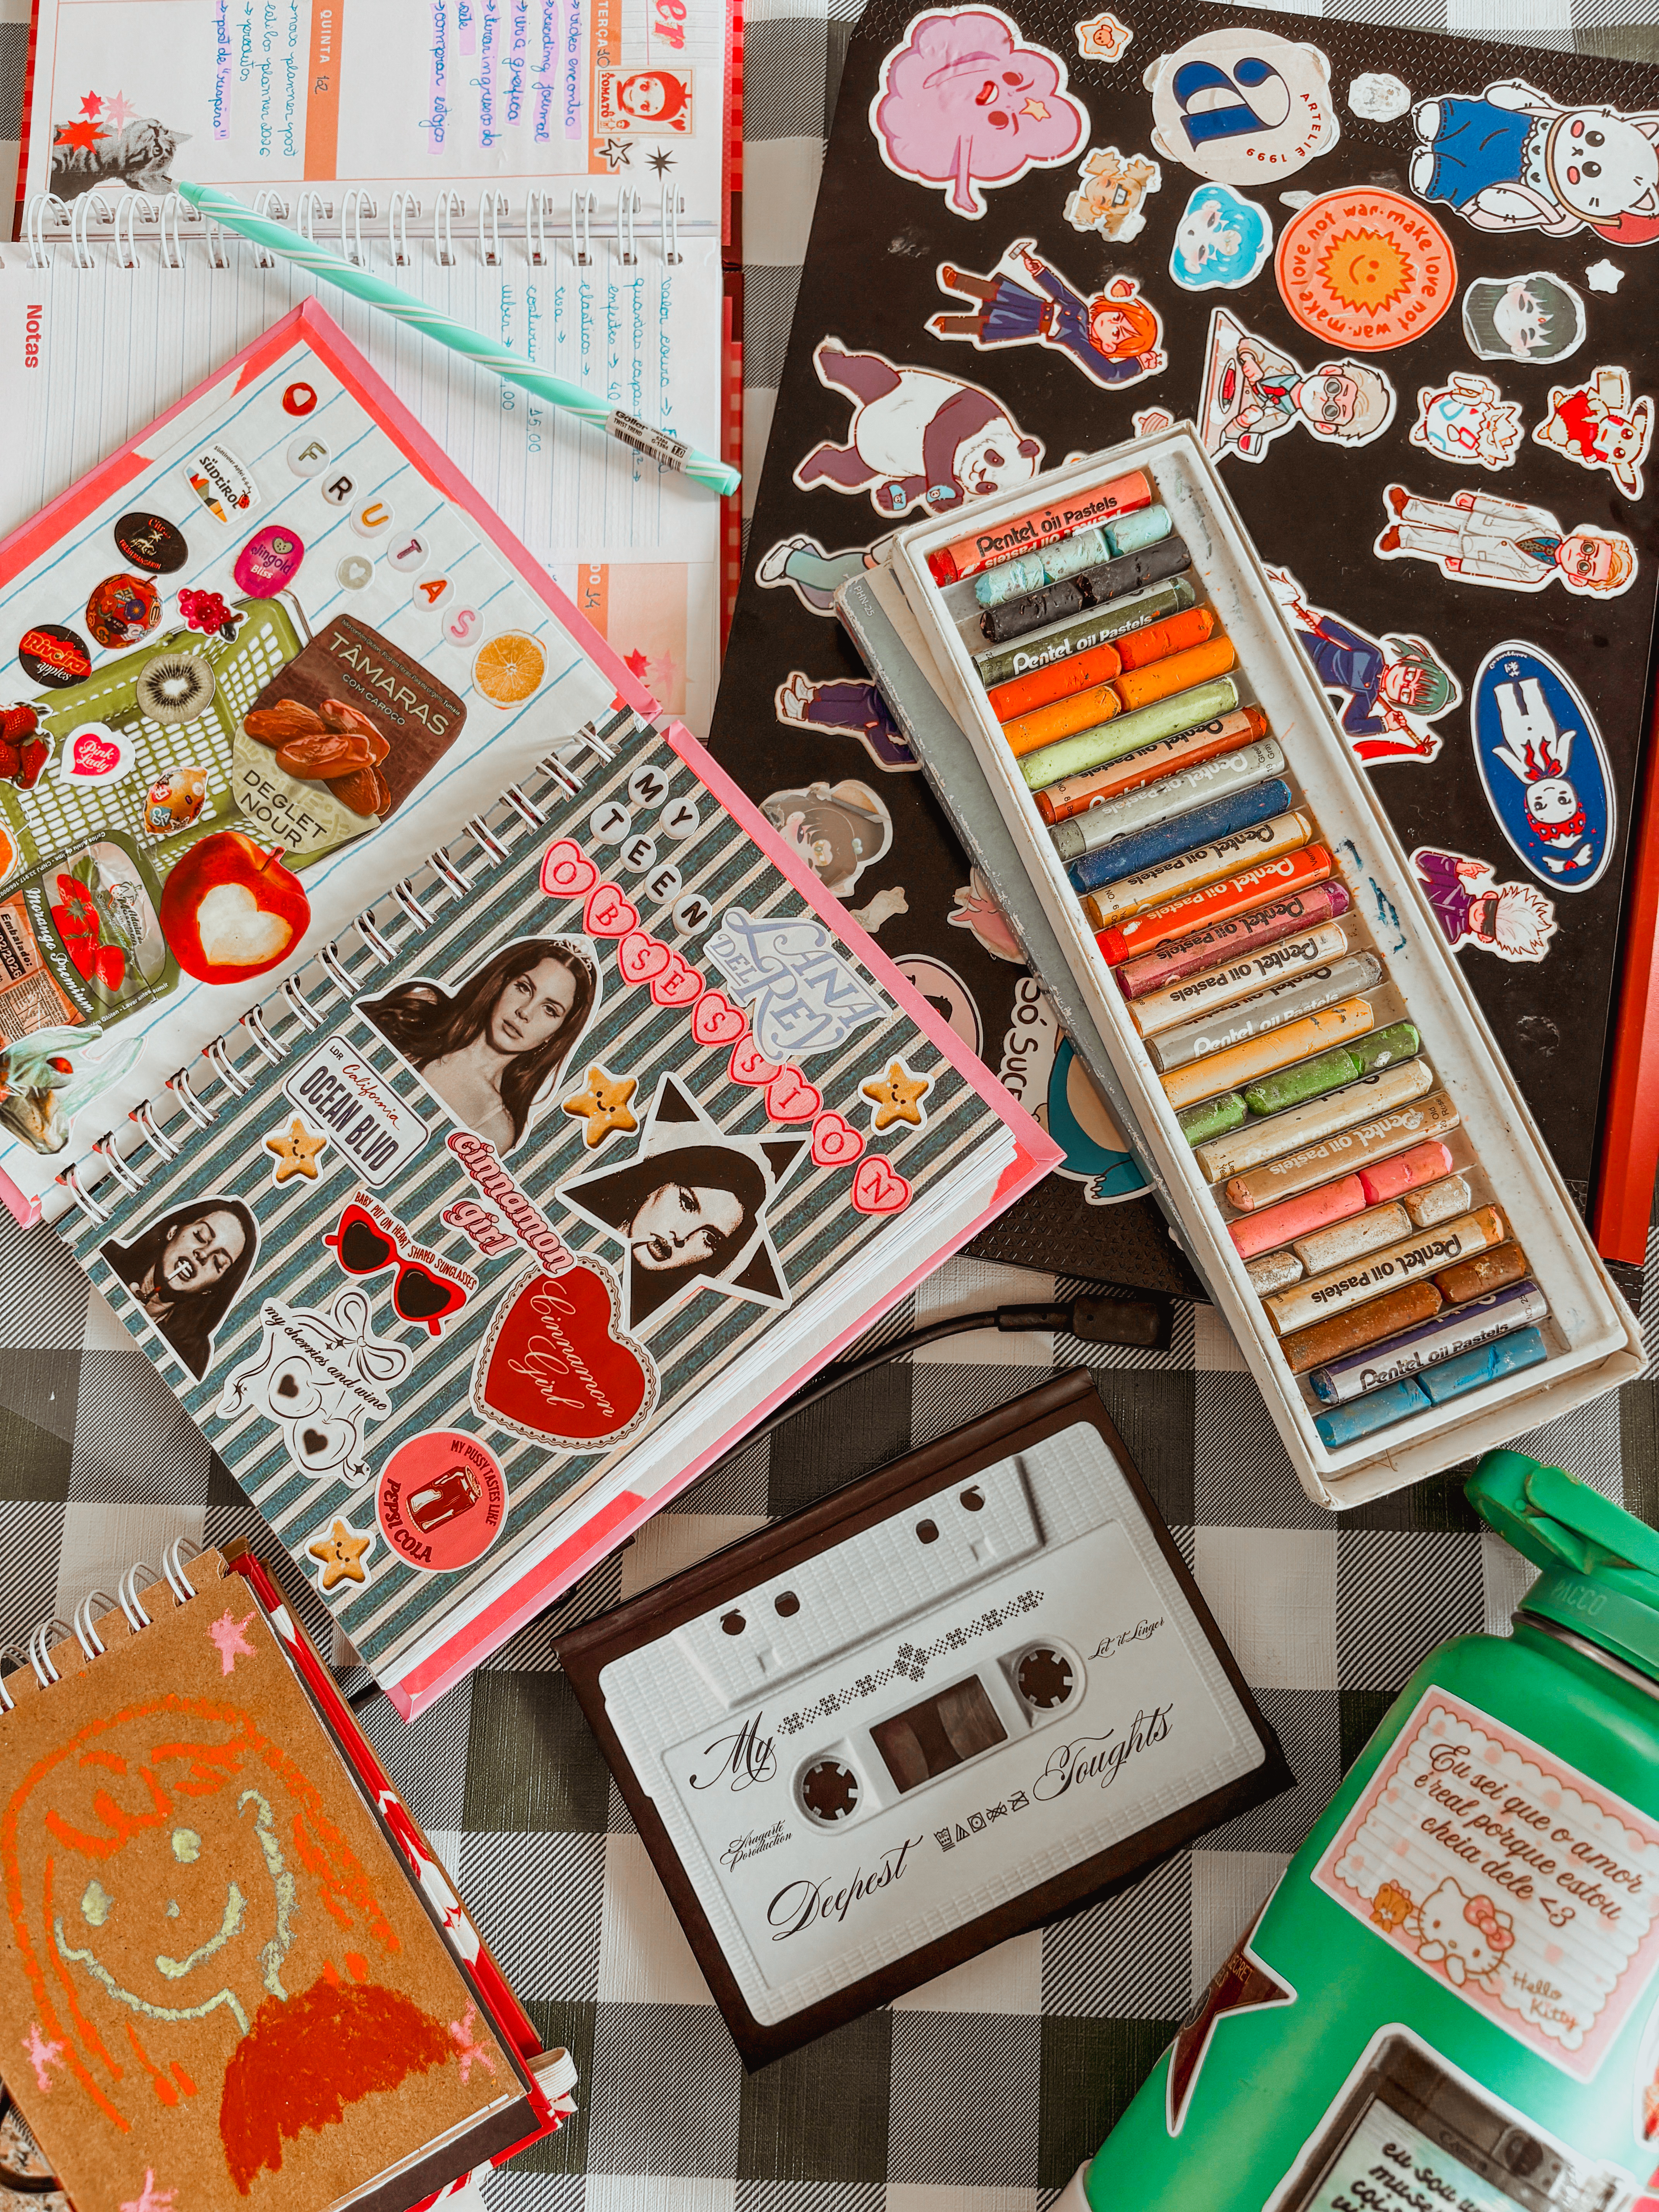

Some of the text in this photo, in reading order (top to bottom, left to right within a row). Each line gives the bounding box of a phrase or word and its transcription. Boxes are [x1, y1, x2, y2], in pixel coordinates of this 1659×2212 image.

[319, 9, 333, 64] QUINTA
[597, 0, 610, 48] TERÇA
[216, 48, 232, 65] de
[600, 72, 615, 118] TOMATO
[1246, 148, 1287, 163] 1999
[1291, 204, 1442, 338] make love not war make love not war
[24, 304, 43, 369] Notas
[613, 417, 643, 437] TWIST TREND
[615, 409, 648, 431] Göller
[976, 521, 1038, 558] Pentel
[1063, 495, 1118, 529] Pastels
[251, 544, 294, 575] Jingold
[251, 565, 273, 580] Bliss
[854, 585, 875, 617] PHN-25
[24, 632, 88, 674] Rivoira
[37, 662, 72, 681] apples
[1013, 641, 1073, 676] Pentel
[1099, 614, 1152, 642] Pastels
[328, 632, 450, 736] TÂMARAS
[342, 673, 406, 726] COM CAROÇO
[76, 752, 110, 772] Lady
[79, 740, 114, 760] Pink
[240, 792, 303, 848] NOUR
[243, 770, 327, 840] DEGLET
[635, 772, 693, 826] MY
[601, 808, 708, 928] TEEN
[1214, 823, 1275, 859] Pentel
[1128, 859, 1186, 886] Pastels
[1232, 859, 1295, 893] Pentel
[1146, 891, 1205, 921] Pastels
[1243, 896, 1305, 932] Pentel
[1, 913, 33, 967] Embalado:
[26, 887, 56, 951] Morango
[50, 952, 95, 1013] Premium
[1254, 937, 1320, 977] Pentel
[1169, 973, 1228, 1003] Pastels
[1193, 1020, 1254, 1058] Pentel
[1283, 992, 1340, 1022] Pastels
[329, 1046, 345, 1061] LDR
[299, 1065, 399, 1171] OCEAN BLVD
[342, 1064, 400, 1131] California
[1268, 1146, 1329, 1176] Pastels
[443, 1201, 517, 1255] girl
[447, 1132, 575, 1275] cinnamon
[355, 1191, 477, 1291] BABY PUT ON HEART SHAPED SUNGLASSES
[1395, 1233, 1463, 1277] Pentel
[1310, 1272, 1371, 1304] Pastels
[264, 1306, 387, 1411] my cherries and wine
[508, 1335, 586, 1409] Girl
[530, 1280, 615, 1419] Cinnamon
[1360, 1351, 1425, 1392] Pentel
[1451, 1321, 1510, 1353] Pastels
[451, 1439, 501, 1527] MY PUSSY TASTES LIKE
[394, 1527, 432, 1563] COLA
[1088, 1637, 1115, 1661] Let
[1125, 1617, 1164, 1643] Linger
[689, 1711, 777, 1792] My
[1033, 1703, 1173, 1801] Toughts
[1429, 1743, 1644, 1894] Eu sei que o amor
[1421, 1815, 1576, 1928] cheia dele <3
[1429, 1779, 1474, 1817] real
[1463, 1812, 1557, 1875] porque
[1556, 1870, 1625, 1921] estou
[767, 1835, 923, 1941] Deepest
[1510, 1970, 1564, 2001] Hello
[1530, 1997, 1581, 2030] Kitty
[1383, 2142, 1413, 2169] eu
[1414, 2165, 1457, 2205] sou
